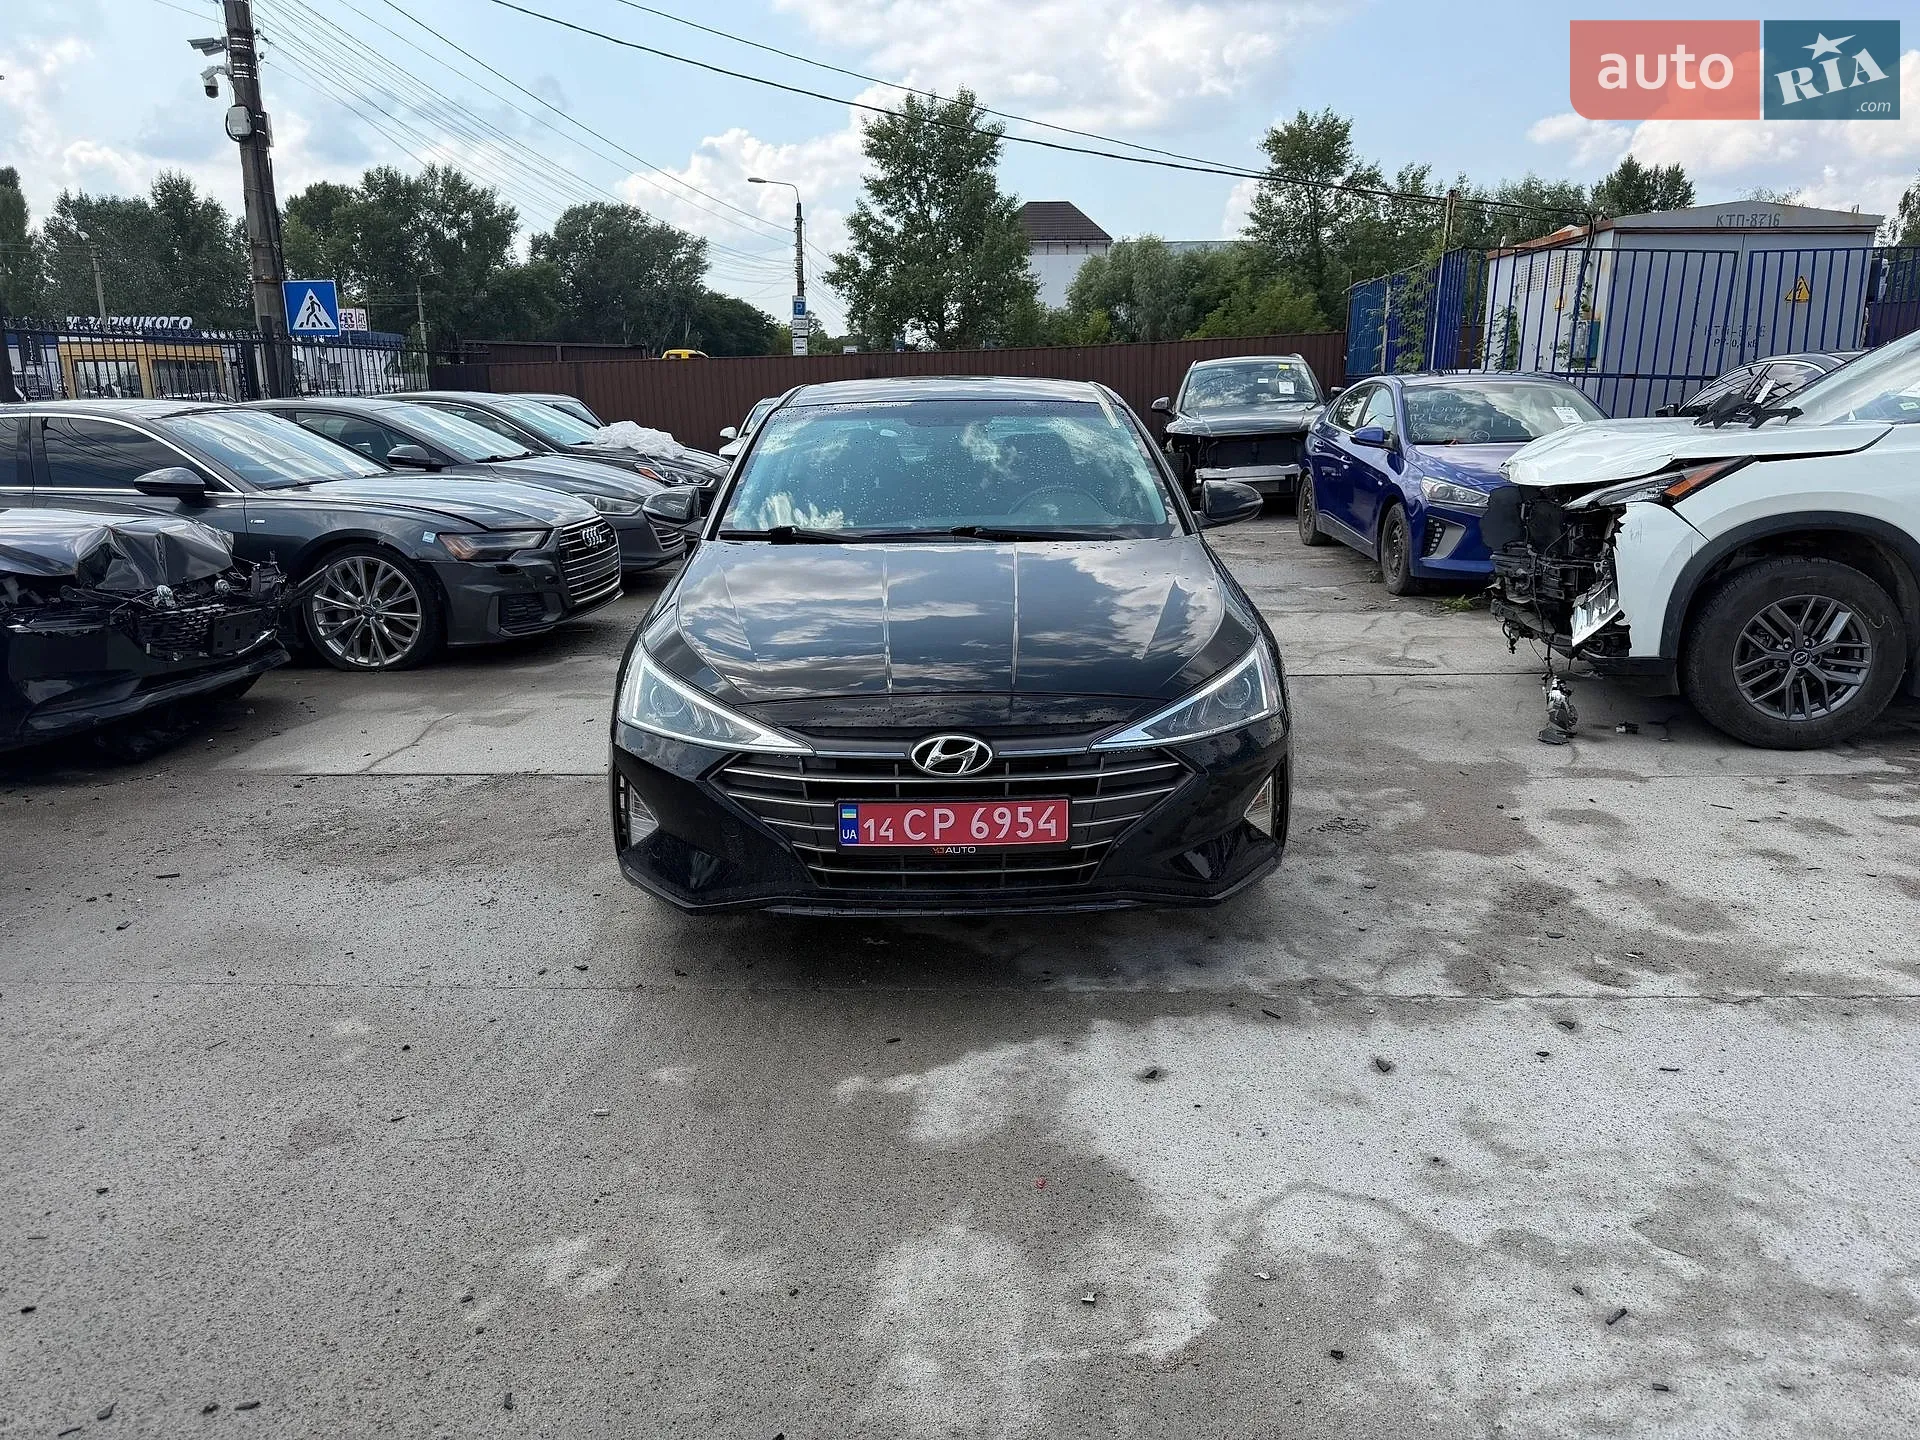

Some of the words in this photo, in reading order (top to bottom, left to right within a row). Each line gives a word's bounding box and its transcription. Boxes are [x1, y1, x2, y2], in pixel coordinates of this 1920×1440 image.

[842, 829, 857, 839] UA
[863, 817, 893, 842] 14
[903, 808, 955, 841] CP
[970, 805, 1057, 840] 6954
